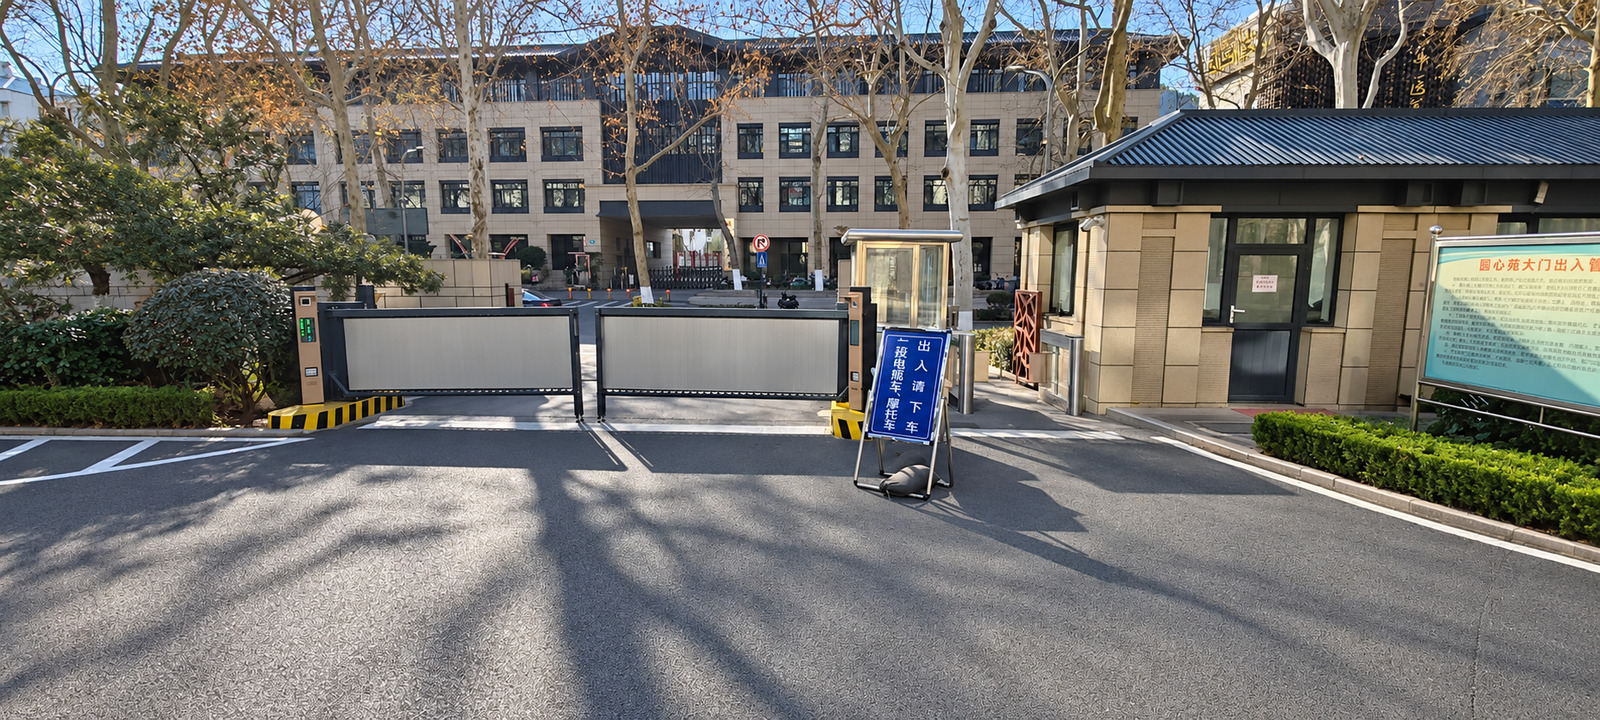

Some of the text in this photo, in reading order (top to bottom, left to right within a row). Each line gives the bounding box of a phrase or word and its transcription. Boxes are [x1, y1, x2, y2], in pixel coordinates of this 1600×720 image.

[905, 339, 931, 434] 出入请下车
